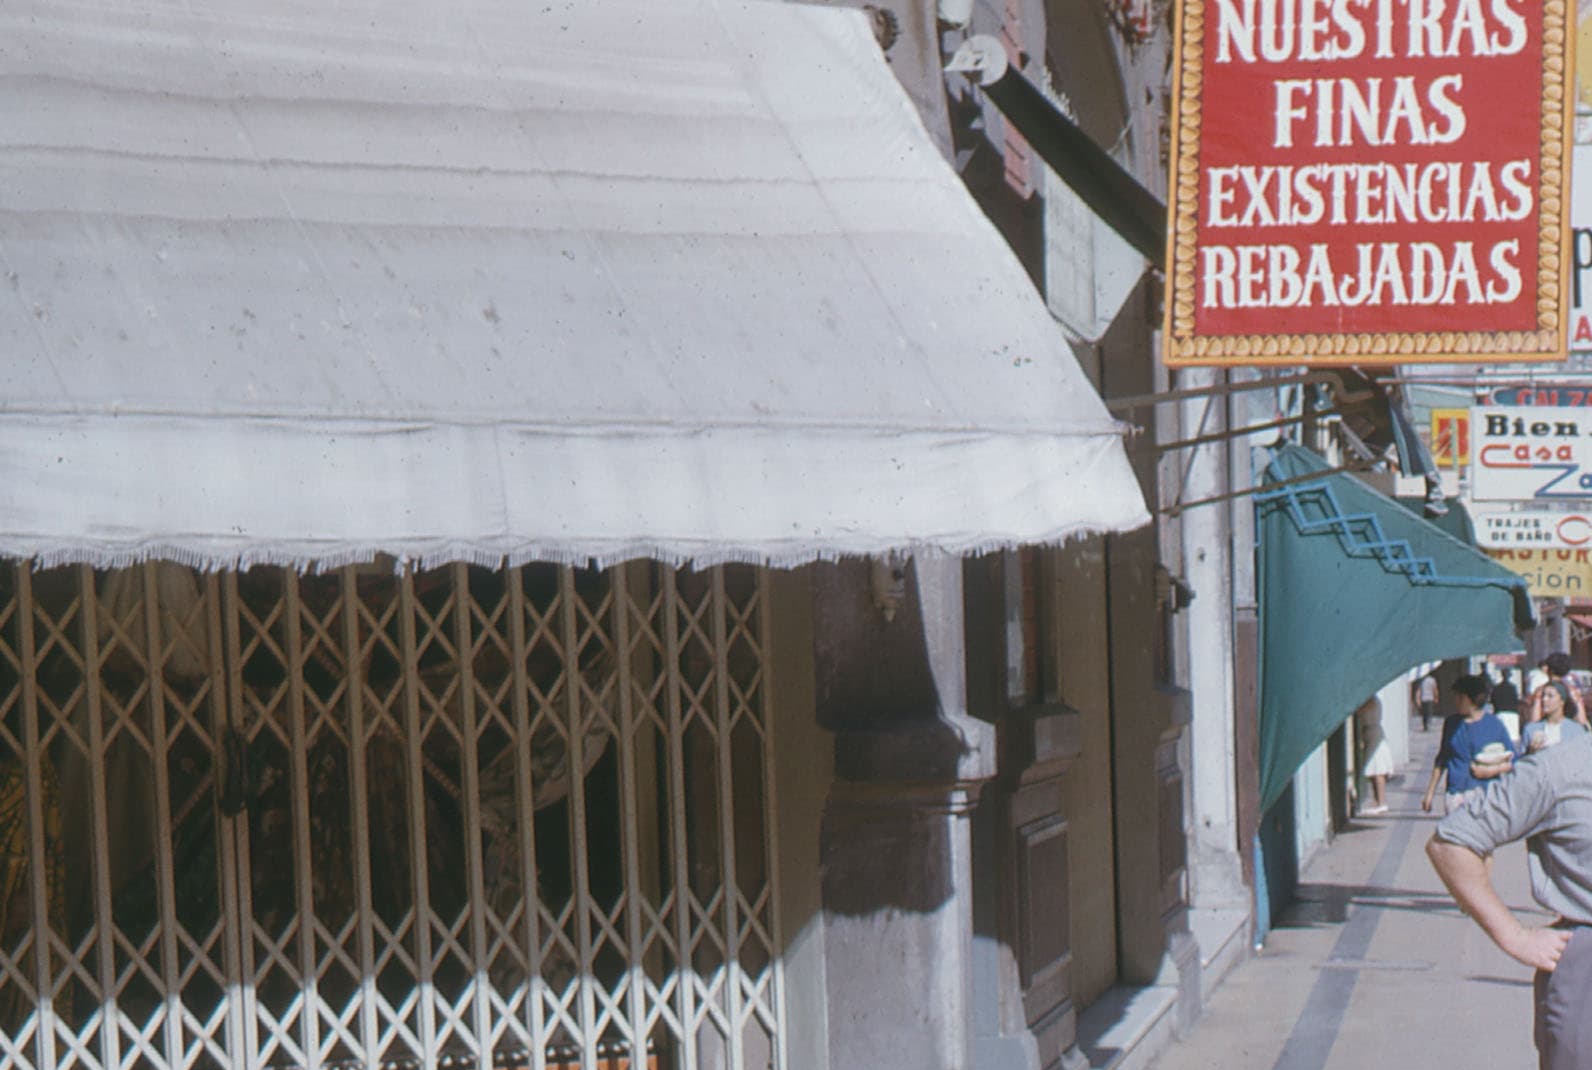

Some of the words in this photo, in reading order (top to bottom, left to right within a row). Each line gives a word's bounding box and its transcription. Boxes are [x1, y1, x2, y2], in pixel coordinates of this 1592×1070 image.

[1215, 0, 1528, 63] NUESTRAS
[1273, 75, 1466, 148] FINAS
[1206, 159, 1533, 228] EXISTENCIAS
[1202, 239, 1523, 309] REBAJADAS
[1485, 415, 1579, 437] Bien
[1480, 444, 1573, 468] Casa
[1487, 518, 1540, 529] TRAJES
[1491, 532, 1506, 541] DE
[1526, 567, 1582, 590] ción
